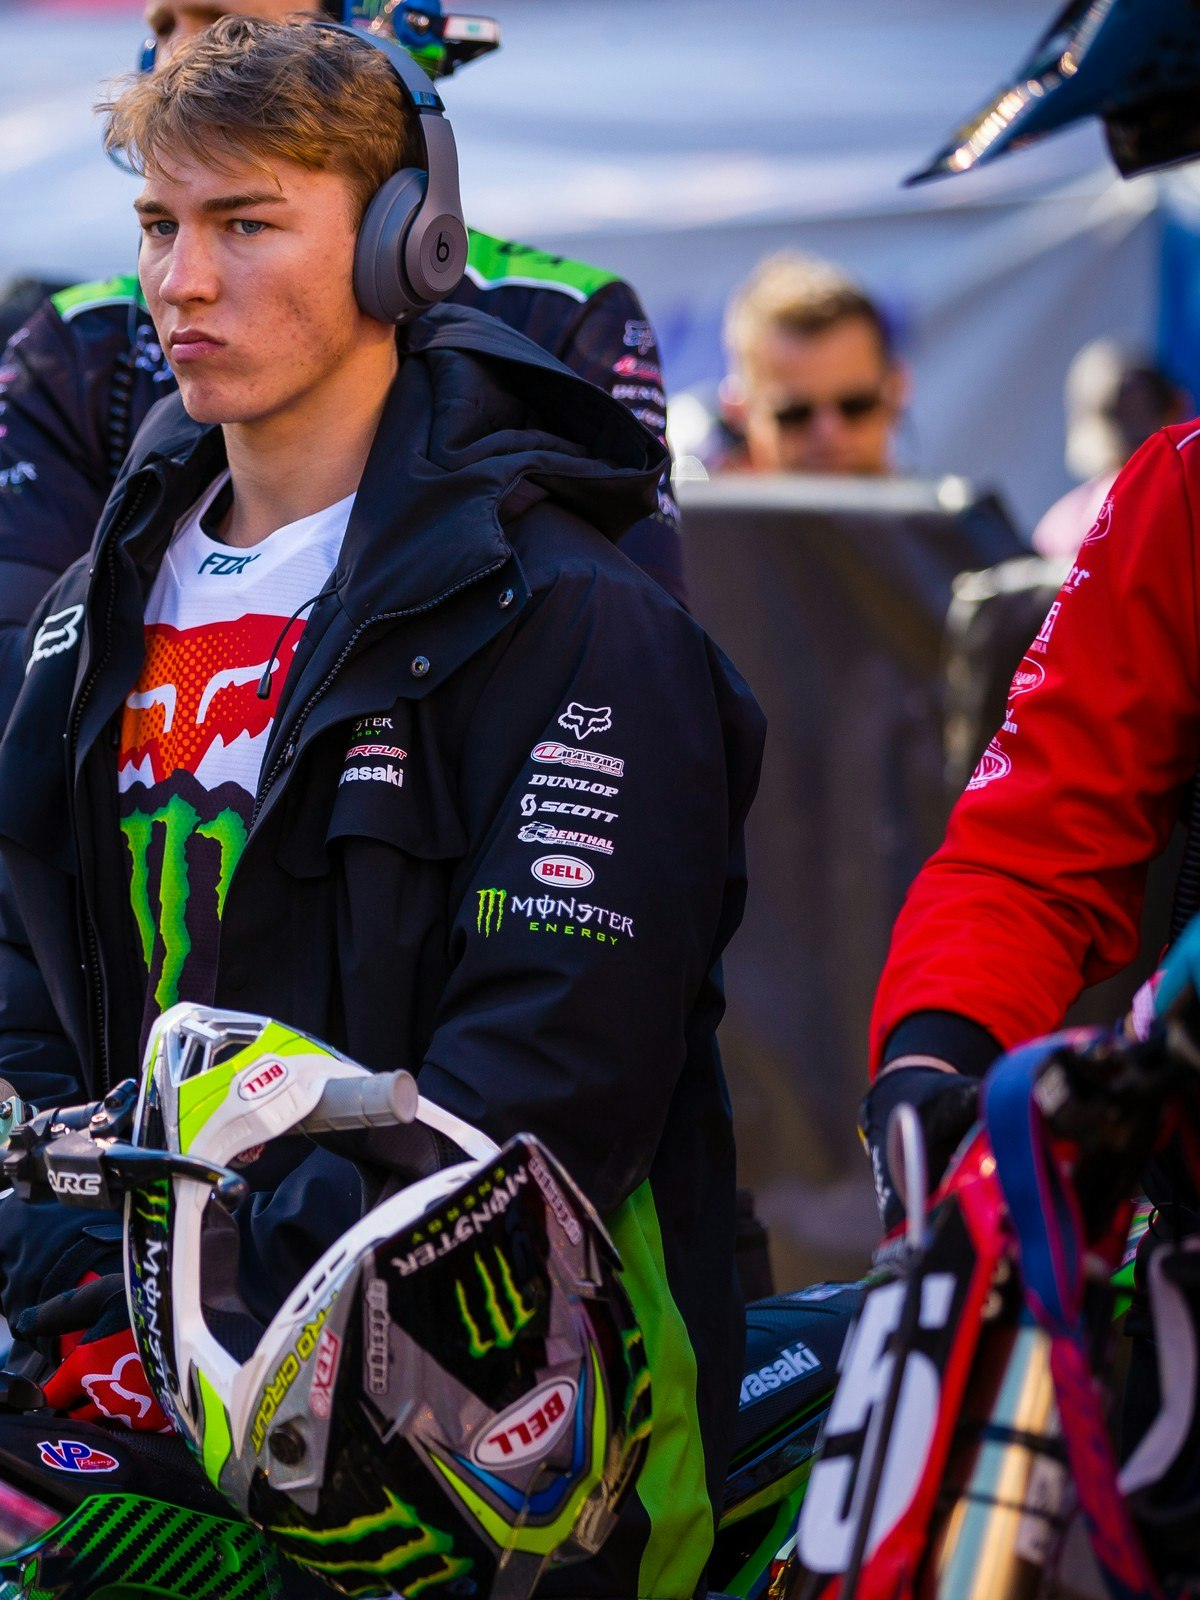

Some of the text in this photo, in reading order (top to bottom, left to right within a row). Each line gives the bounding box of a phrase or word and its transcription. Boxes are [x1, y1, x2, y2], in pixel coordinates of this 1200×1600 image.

[198, 552, 261, 575] FOX
[528, 774, 619, 797] DUNLOP
[538, 801, 619, 823] SCOTT
[545, 828, 614, 850] RENTHAL
[542, 863, 584, 881] BELL
[511, 895, 635, 937] MONSTER
[529, 922, 618, 946] ENERGY
[243, 1064, 284, 1093] BELL
[48, 1173, 102, 1196] ARC
[391, 1164, 529, 1277] MONSTER
[251, 1352, 300, 1459] CIRCUIT
[487, 1391, 566, 1457] BELL
[37, 1440, 93, 1470] VP
